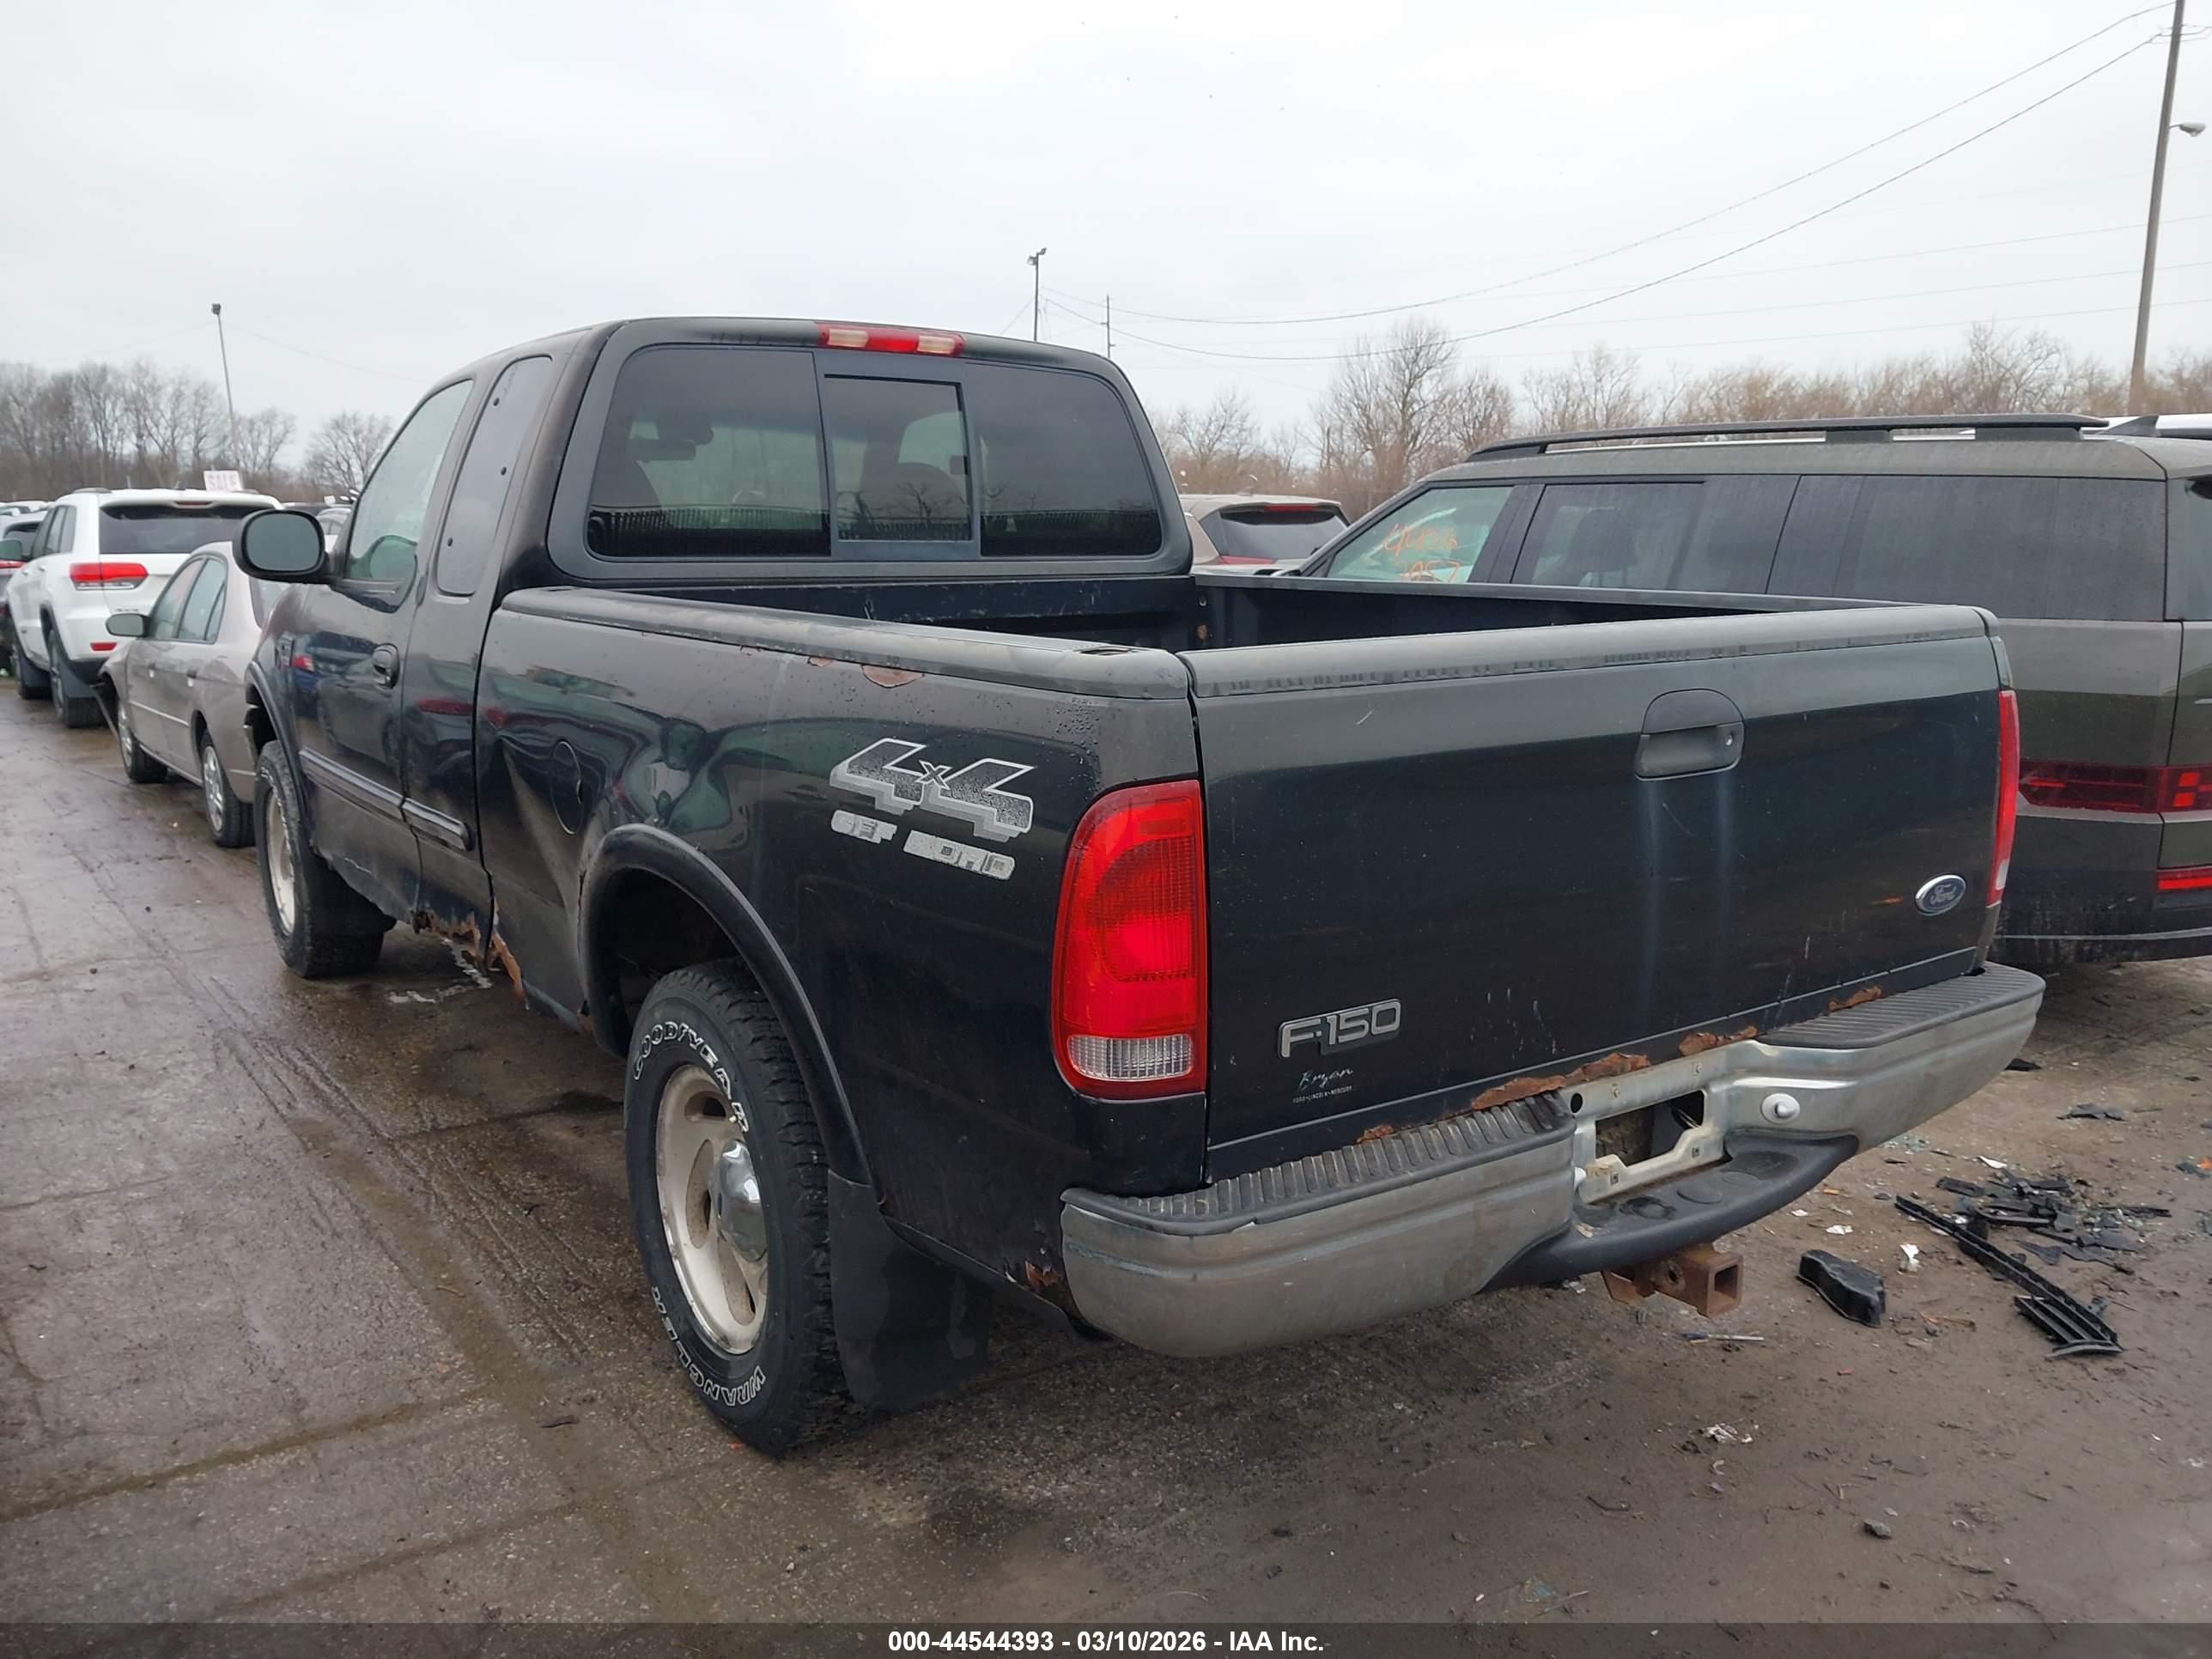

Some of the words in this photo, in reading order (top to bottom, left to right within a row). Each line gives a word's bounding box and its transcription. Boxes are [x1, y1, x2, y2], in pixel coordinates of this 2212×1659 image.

[633, 1020, 750, 1133] GOODYEAR
[1280, 1000, 1402, 1059] F-150
[650, 1285, 767, 1407] WRANGLER
